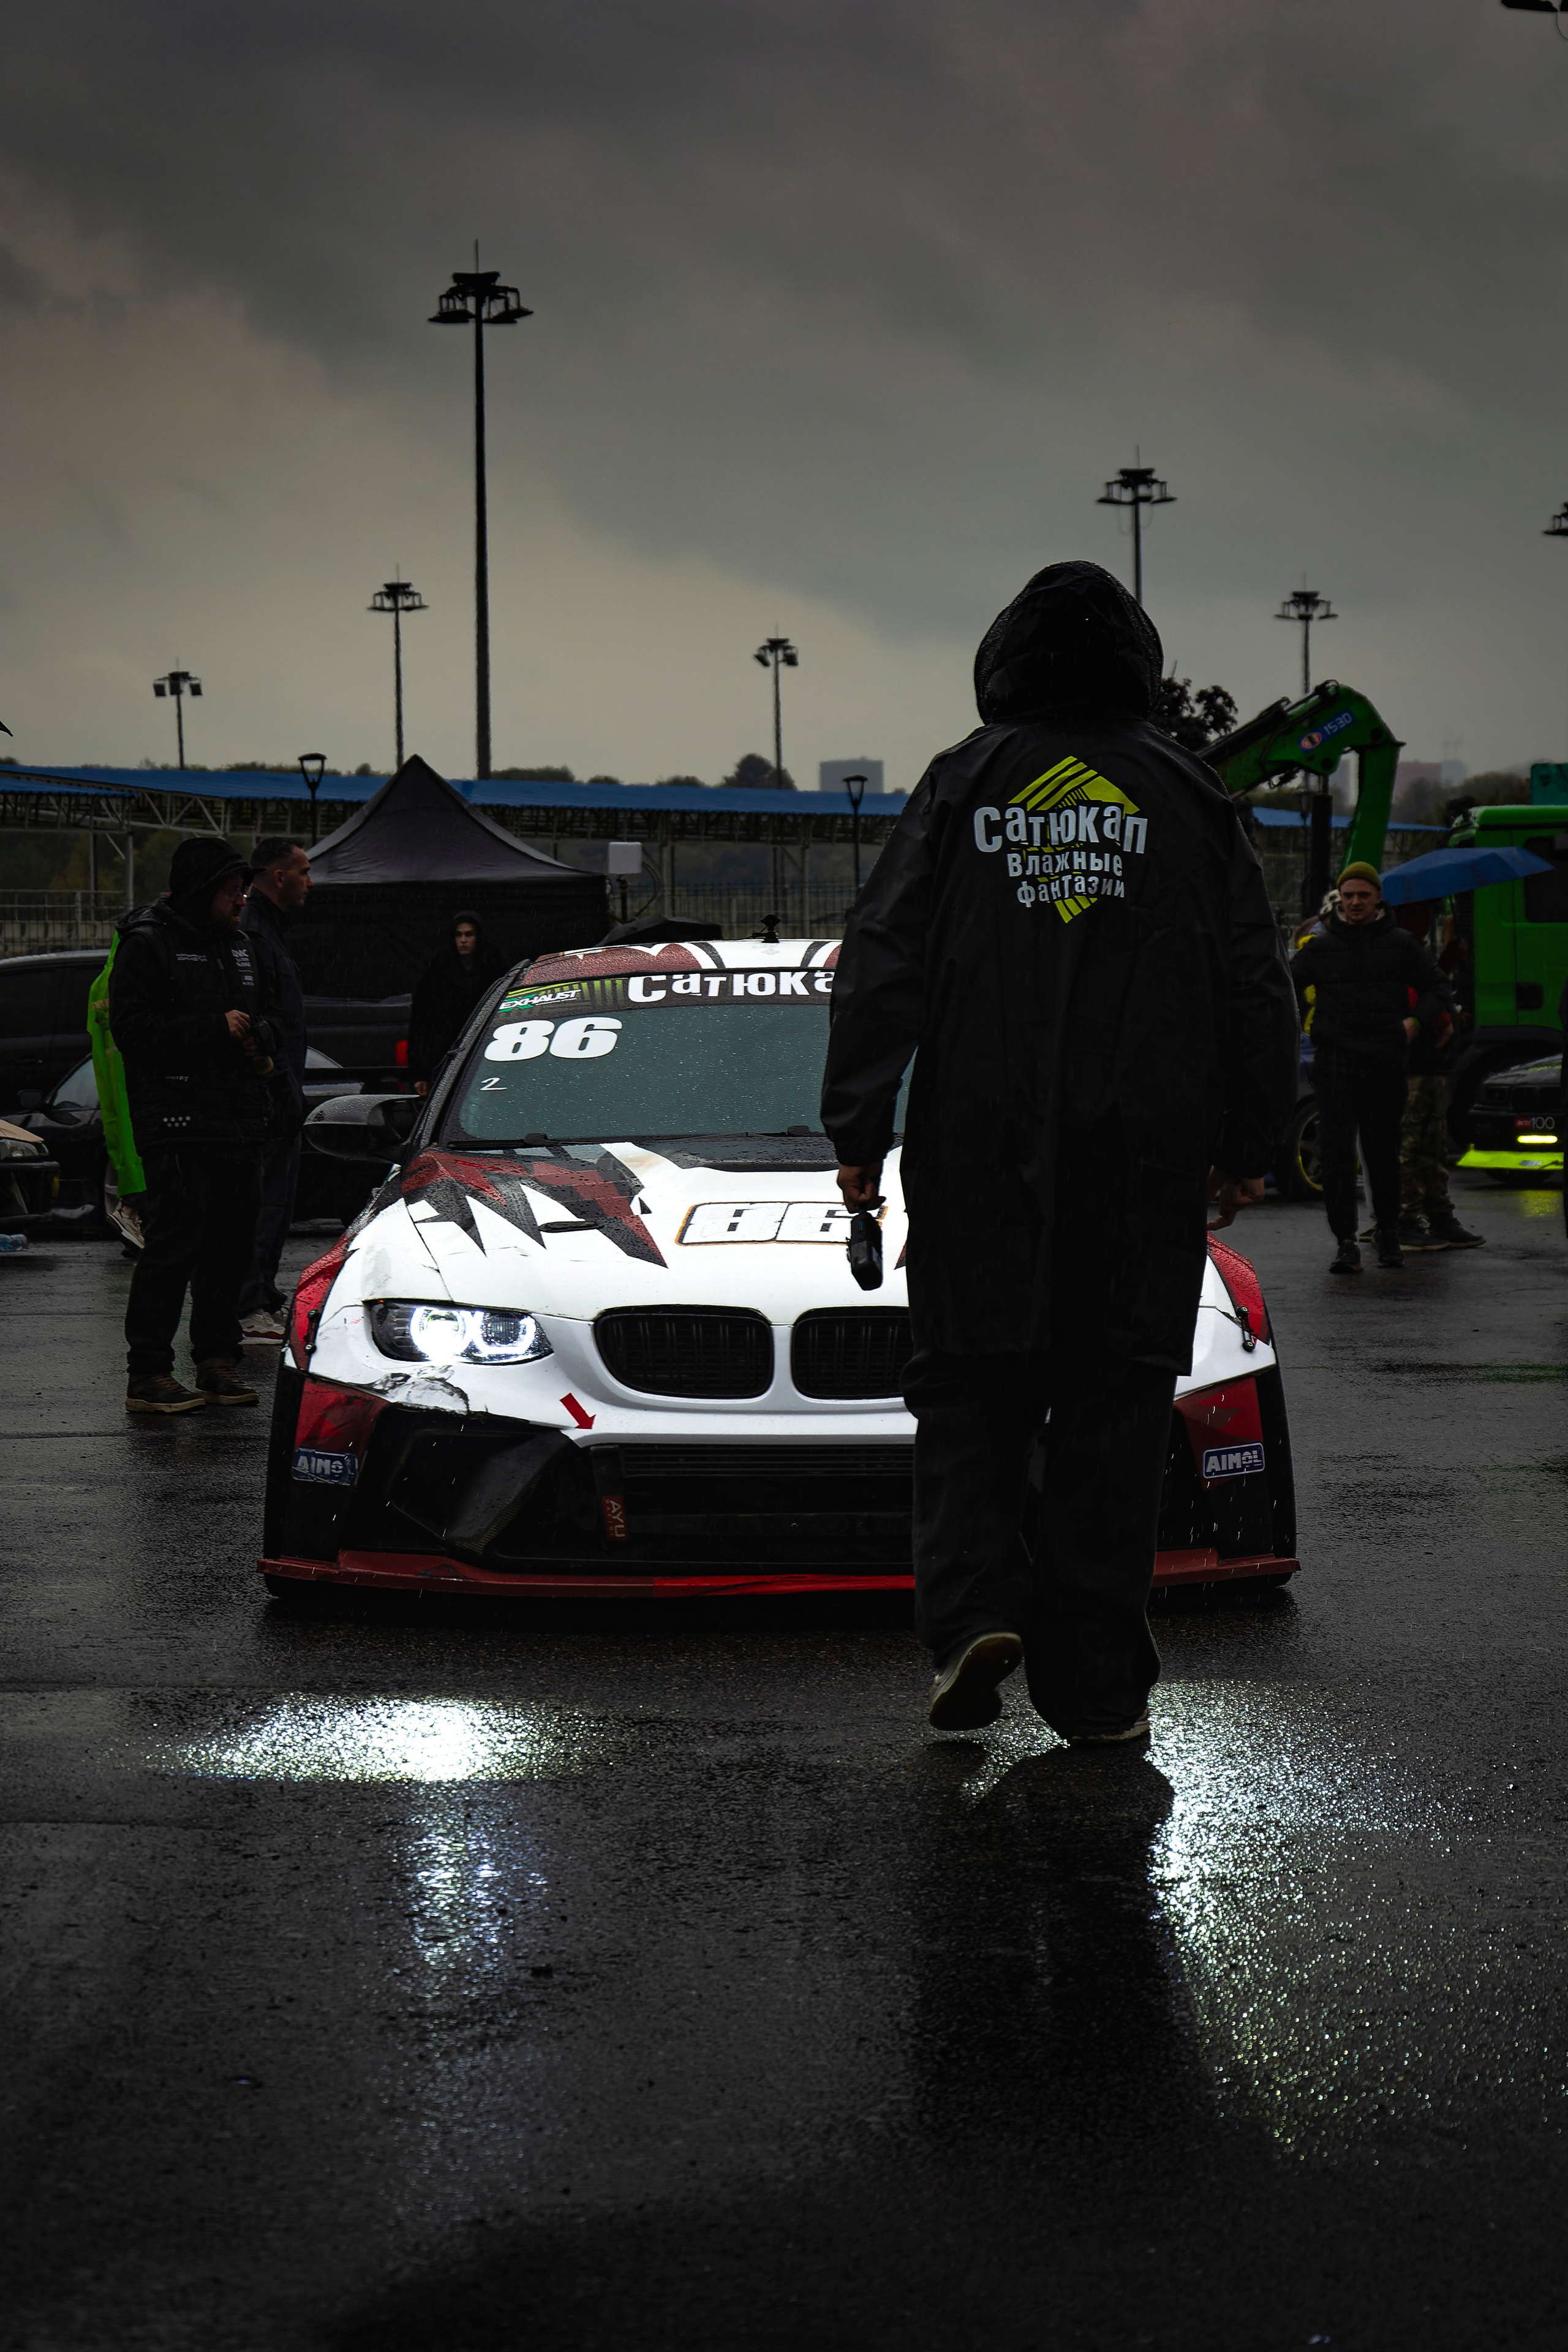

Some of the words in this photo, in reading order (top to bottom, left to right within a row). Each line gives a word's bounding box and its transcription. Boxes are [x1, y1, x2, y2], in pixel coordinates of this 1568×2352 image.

[973, 805, 1148, 854] Сатюкап
[1007, 851, 1123, 877] Влажные
[499, 989, 581, 1010] EXHAUST
[484, 1017, 622, 1061] 86
[480, 1077, 507, 1091] 2
[1531, 1116, 1555, 1130] 100
[1206, 1450, 1262, 1472] AIMOL
[610, 1500, 626, 1537] AYU
